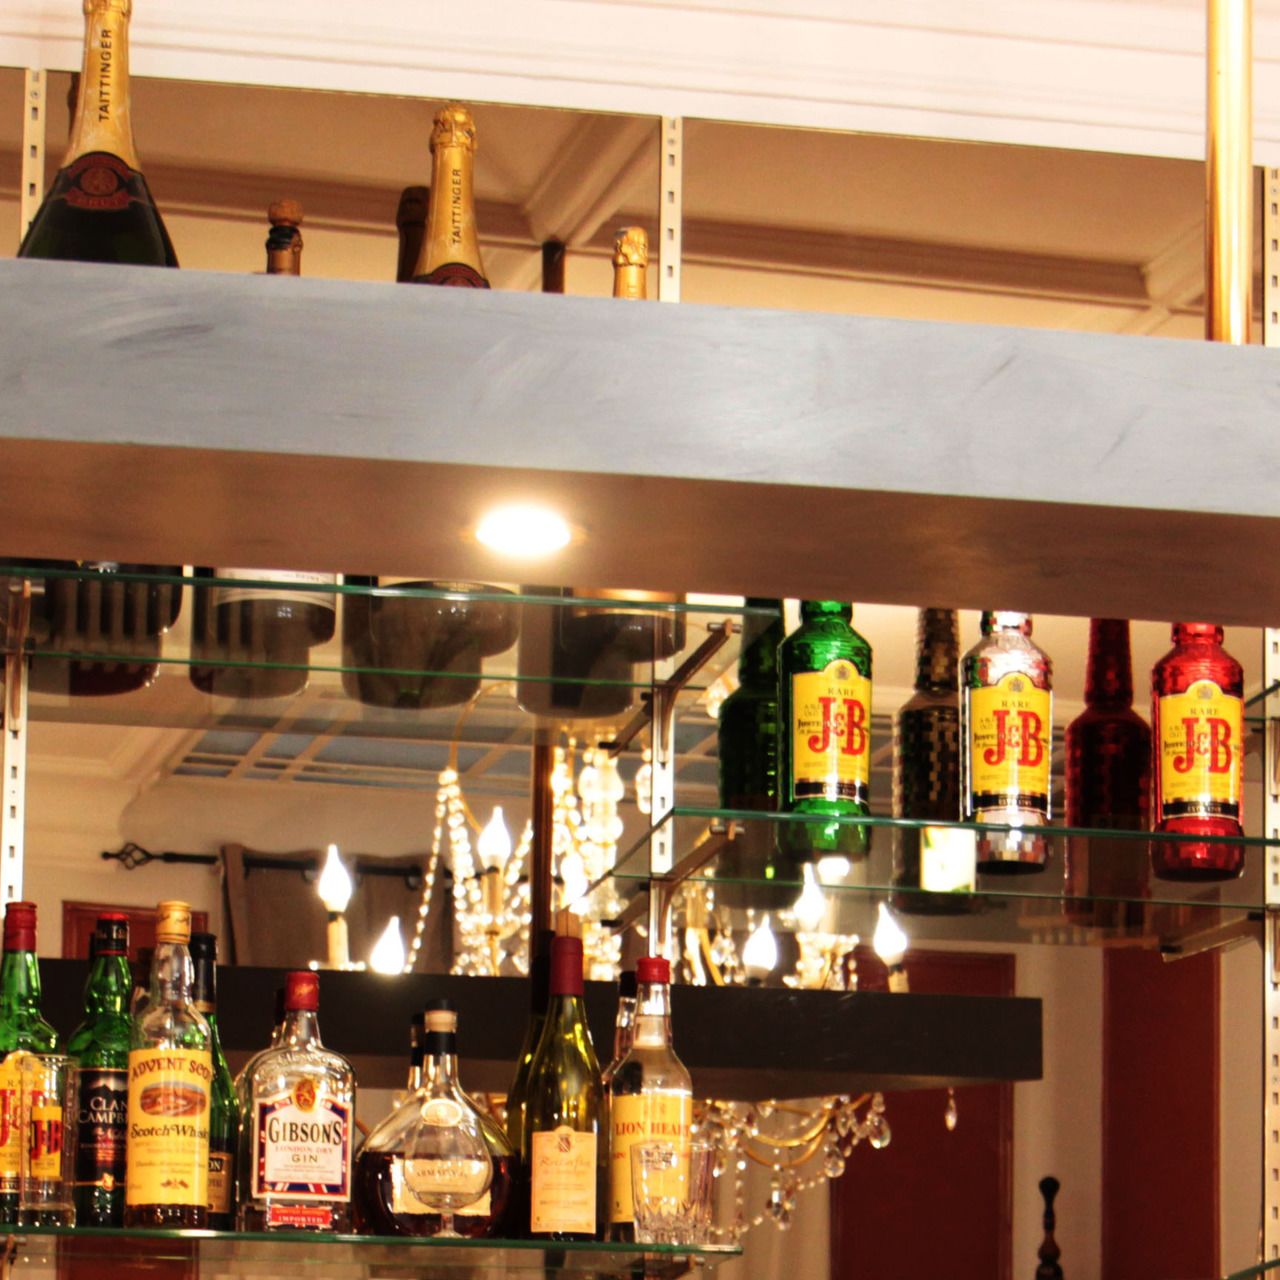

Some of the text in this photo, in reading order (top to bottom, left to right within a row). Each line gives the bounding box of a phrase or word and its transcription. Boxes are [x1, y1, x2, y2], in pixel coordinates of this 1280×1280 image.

[98, 29, 112, 122] TAITTINGER
[452, 168, 462, 245] TAITTINGER
[828, 687, 855, 697] RARE
[1001, 700, 1030, 708] RARE
[1173, 717, 1232, 774] J&B
[131, 1057, 186, 1082] ADVENT
[90, 1096, 128, 1112] CLAN
[78, 1110, 128, 1124] CAMPB
[131, 1123, 170, 1139] Scotch
[268, 1116, 343, 1146] GIBSON'S
[615, 1122, 644, 1136] LION
[291, 1154, 318, 1163] GIN
